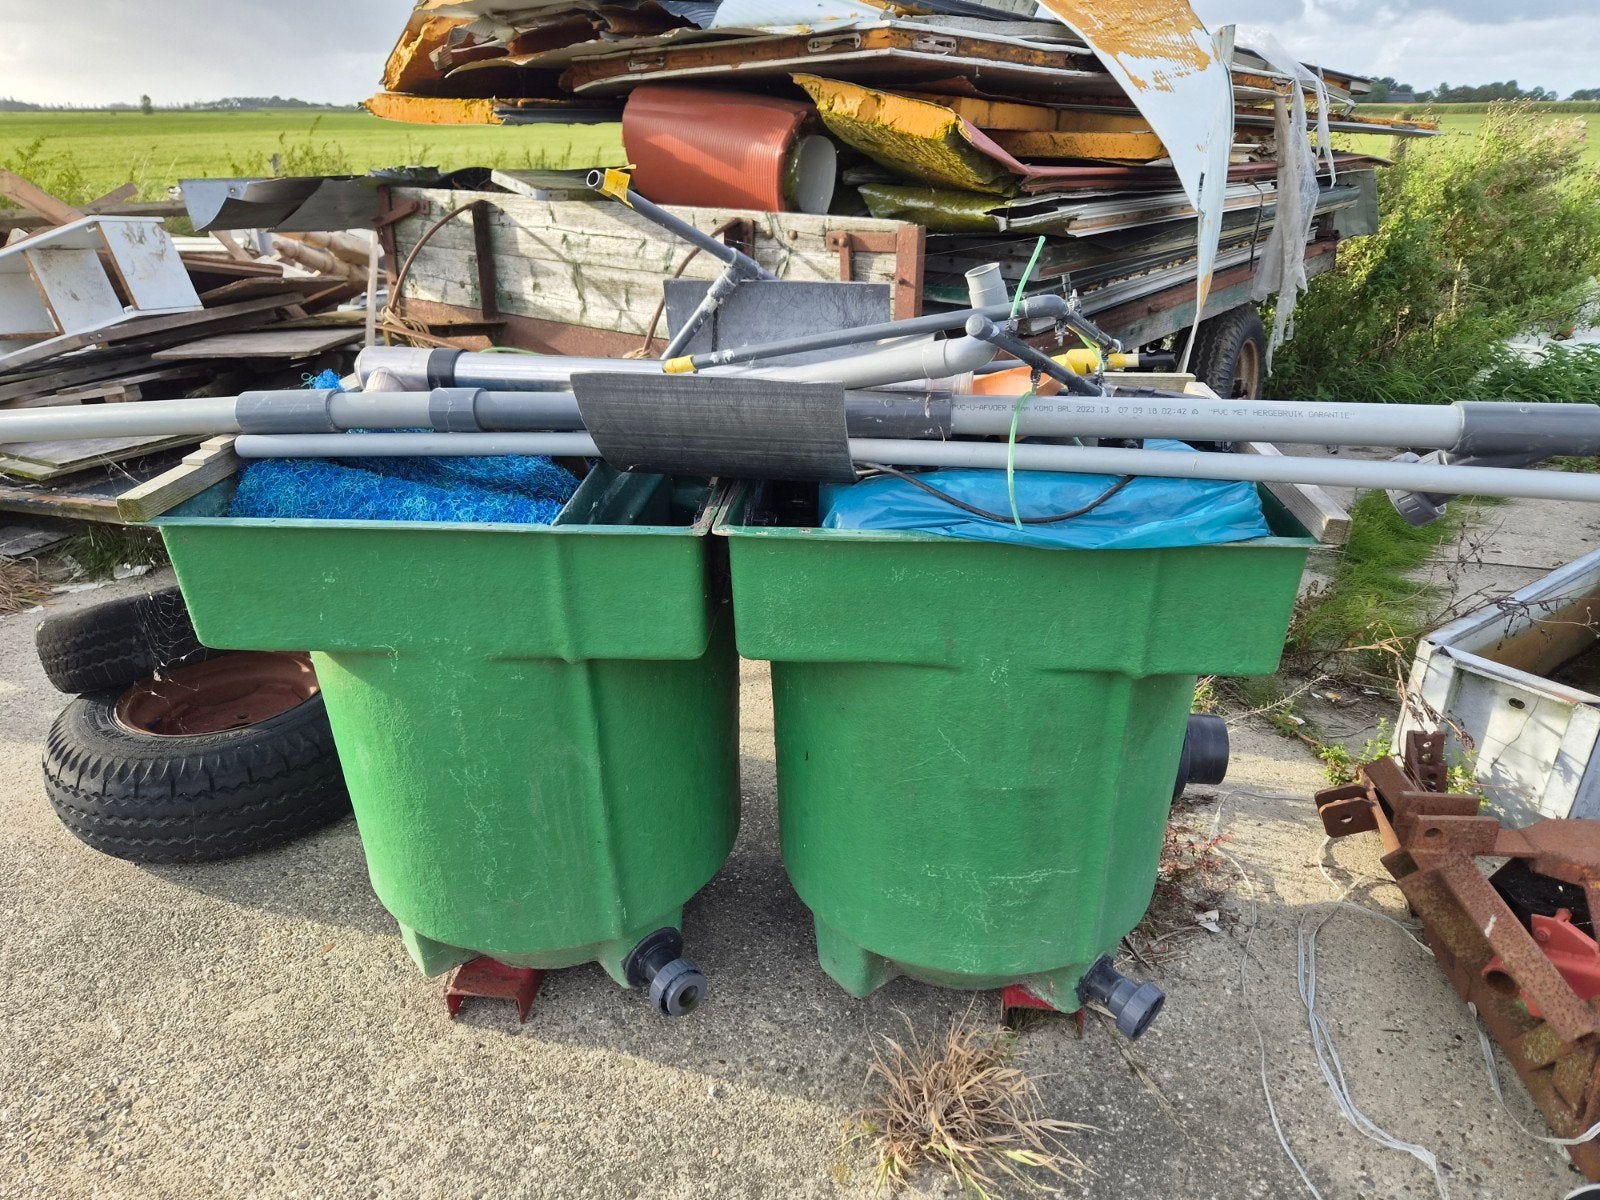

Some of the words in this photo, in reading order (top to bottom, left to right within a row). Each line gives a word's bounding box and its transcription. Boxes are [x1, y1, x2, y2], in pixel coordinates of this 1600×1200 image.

[1011, 404, 1030, 412] 5mm
[1034, 404, 1053, 413] KOMO
[1057, 404, 1072, 413] BRL
[1076, 404, 1095, 413] 2023
[1252, 409, 1304, 418] HERGEBRUIK
